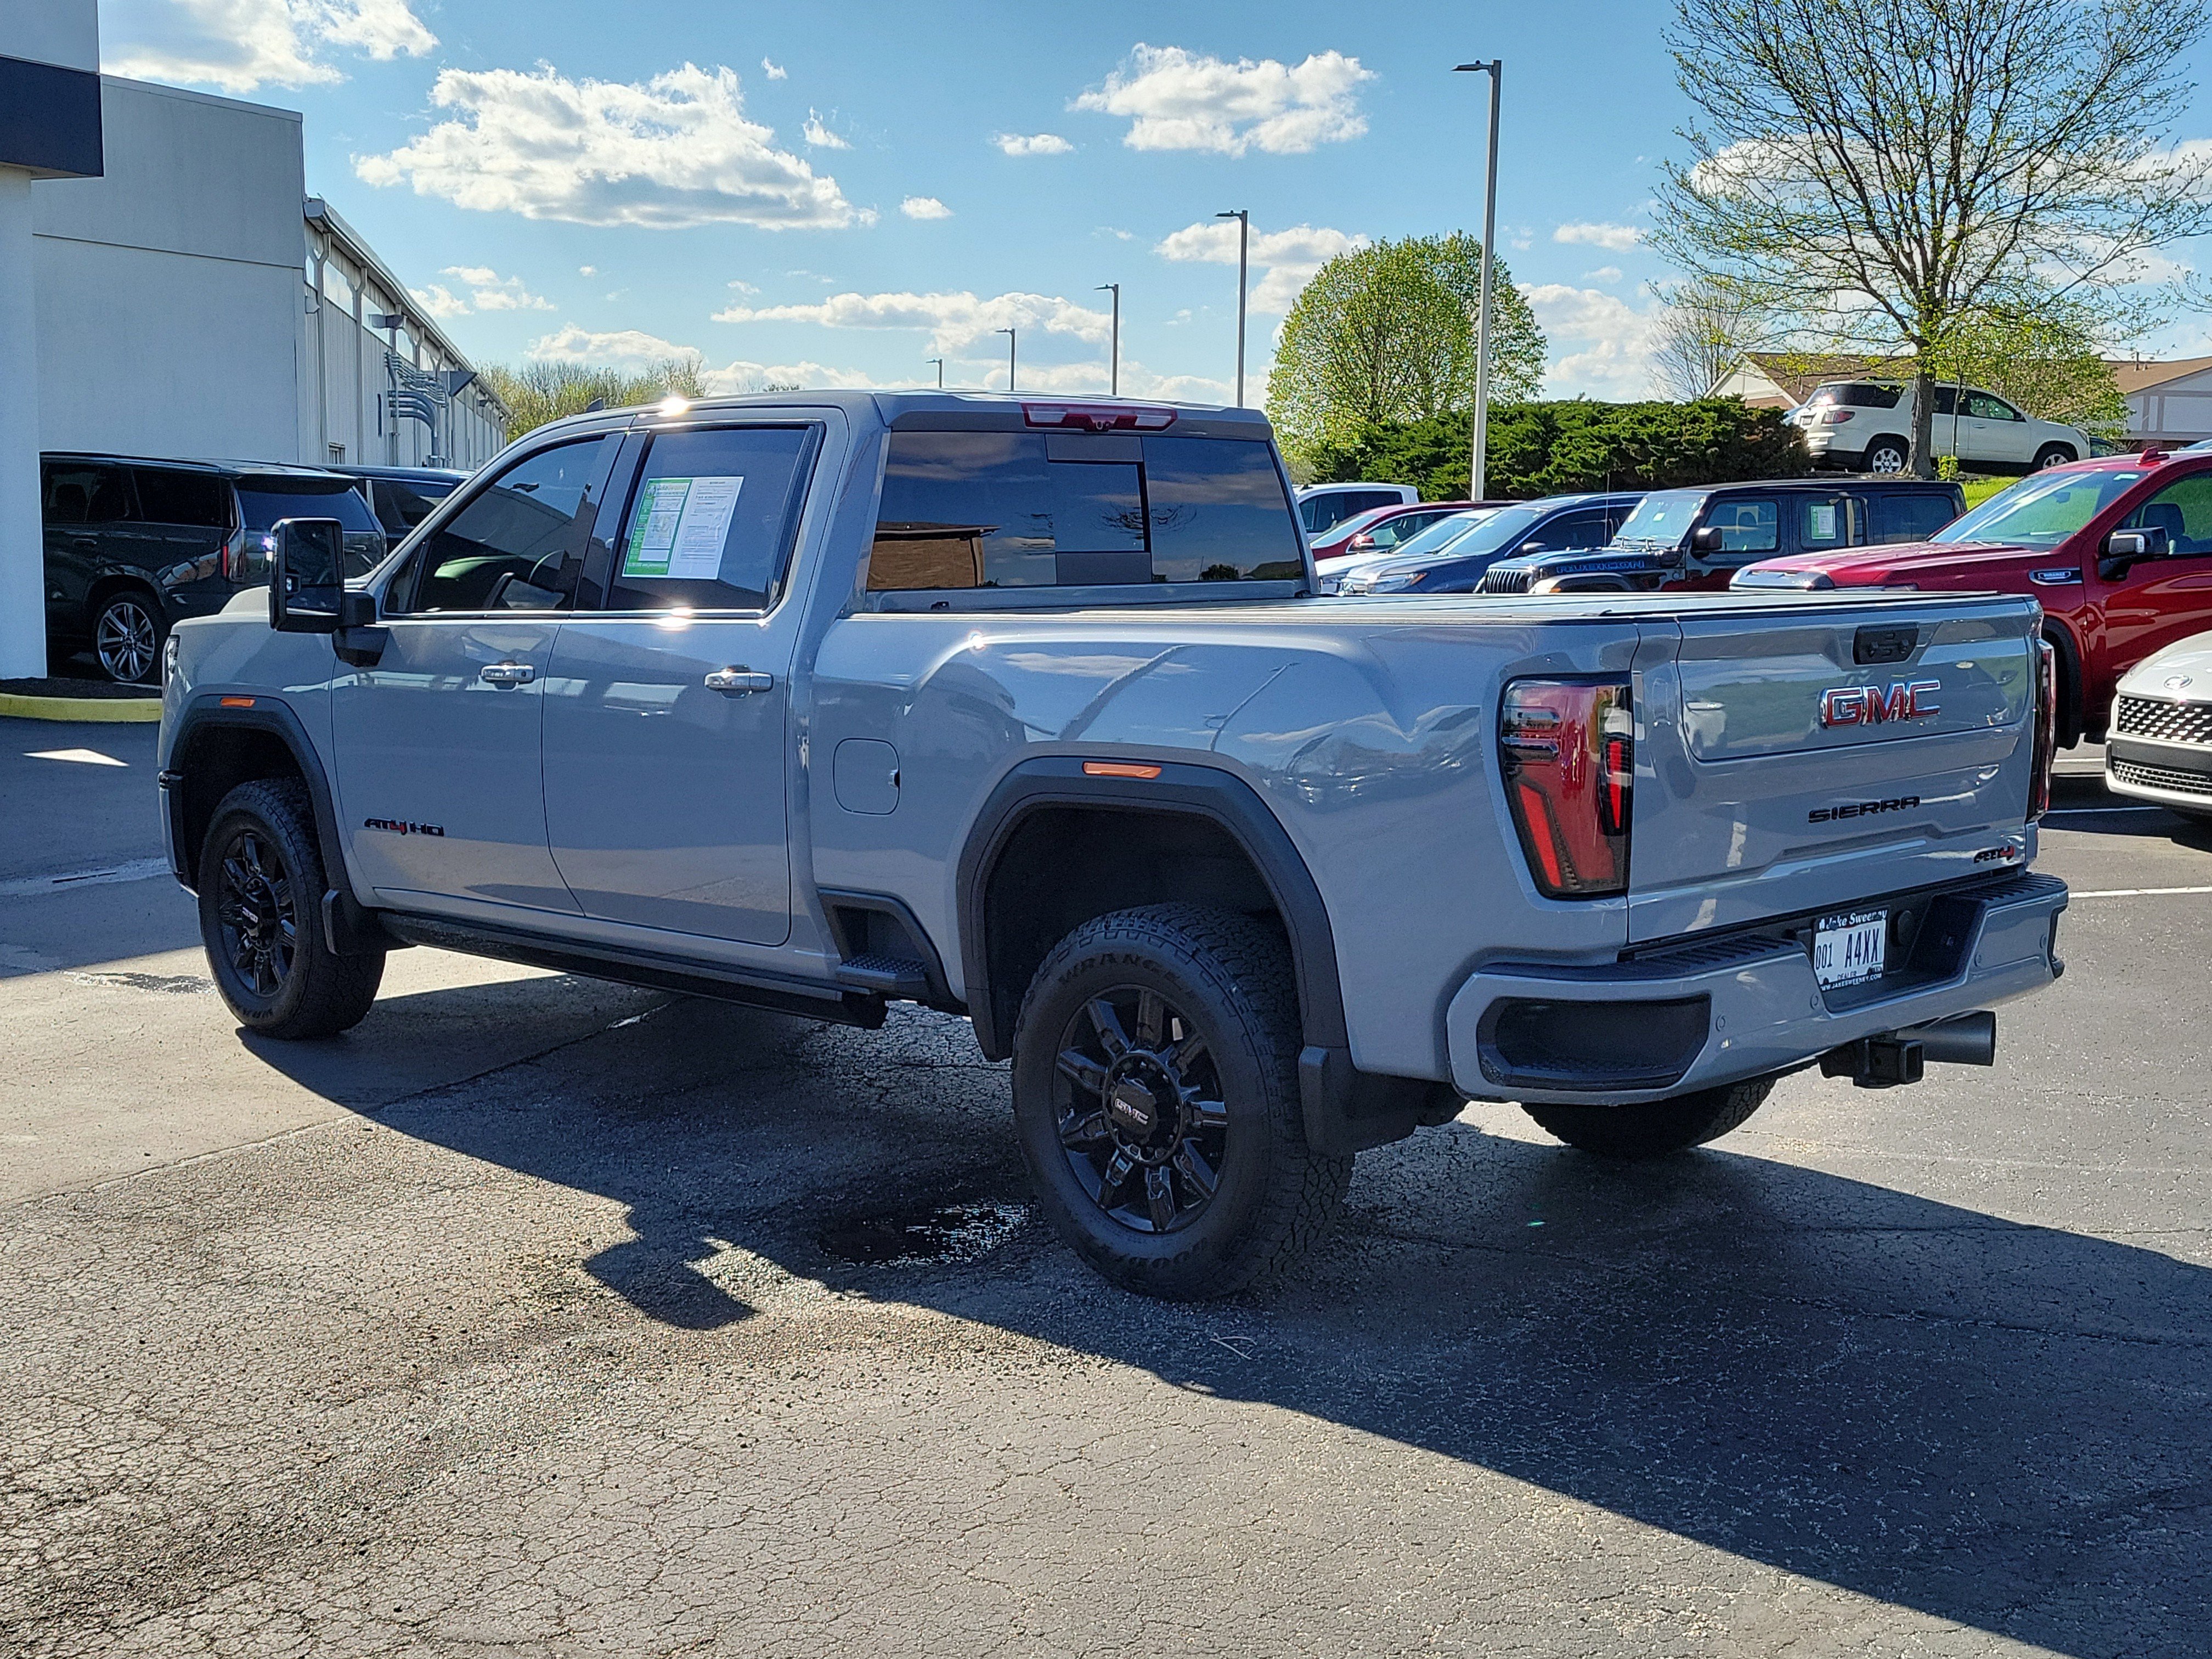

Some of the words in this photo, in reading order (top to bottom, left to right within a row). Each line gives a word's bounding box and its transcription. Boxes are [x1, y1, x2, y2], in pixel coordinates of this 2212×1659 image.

[1820, 679, 1941, 729] GMC
[1808, 795, 1920, 823] SIERRA
[364, 817, 407, 836] AT4
[410, 821, 444, 837] HD
[1974, 845, 2015, 864] AT4
[1815, 942, 1832, 970] 001
[1844, 928, 1879, 968] A4XX
[1115, 1098, 1149, 1125] GMC
